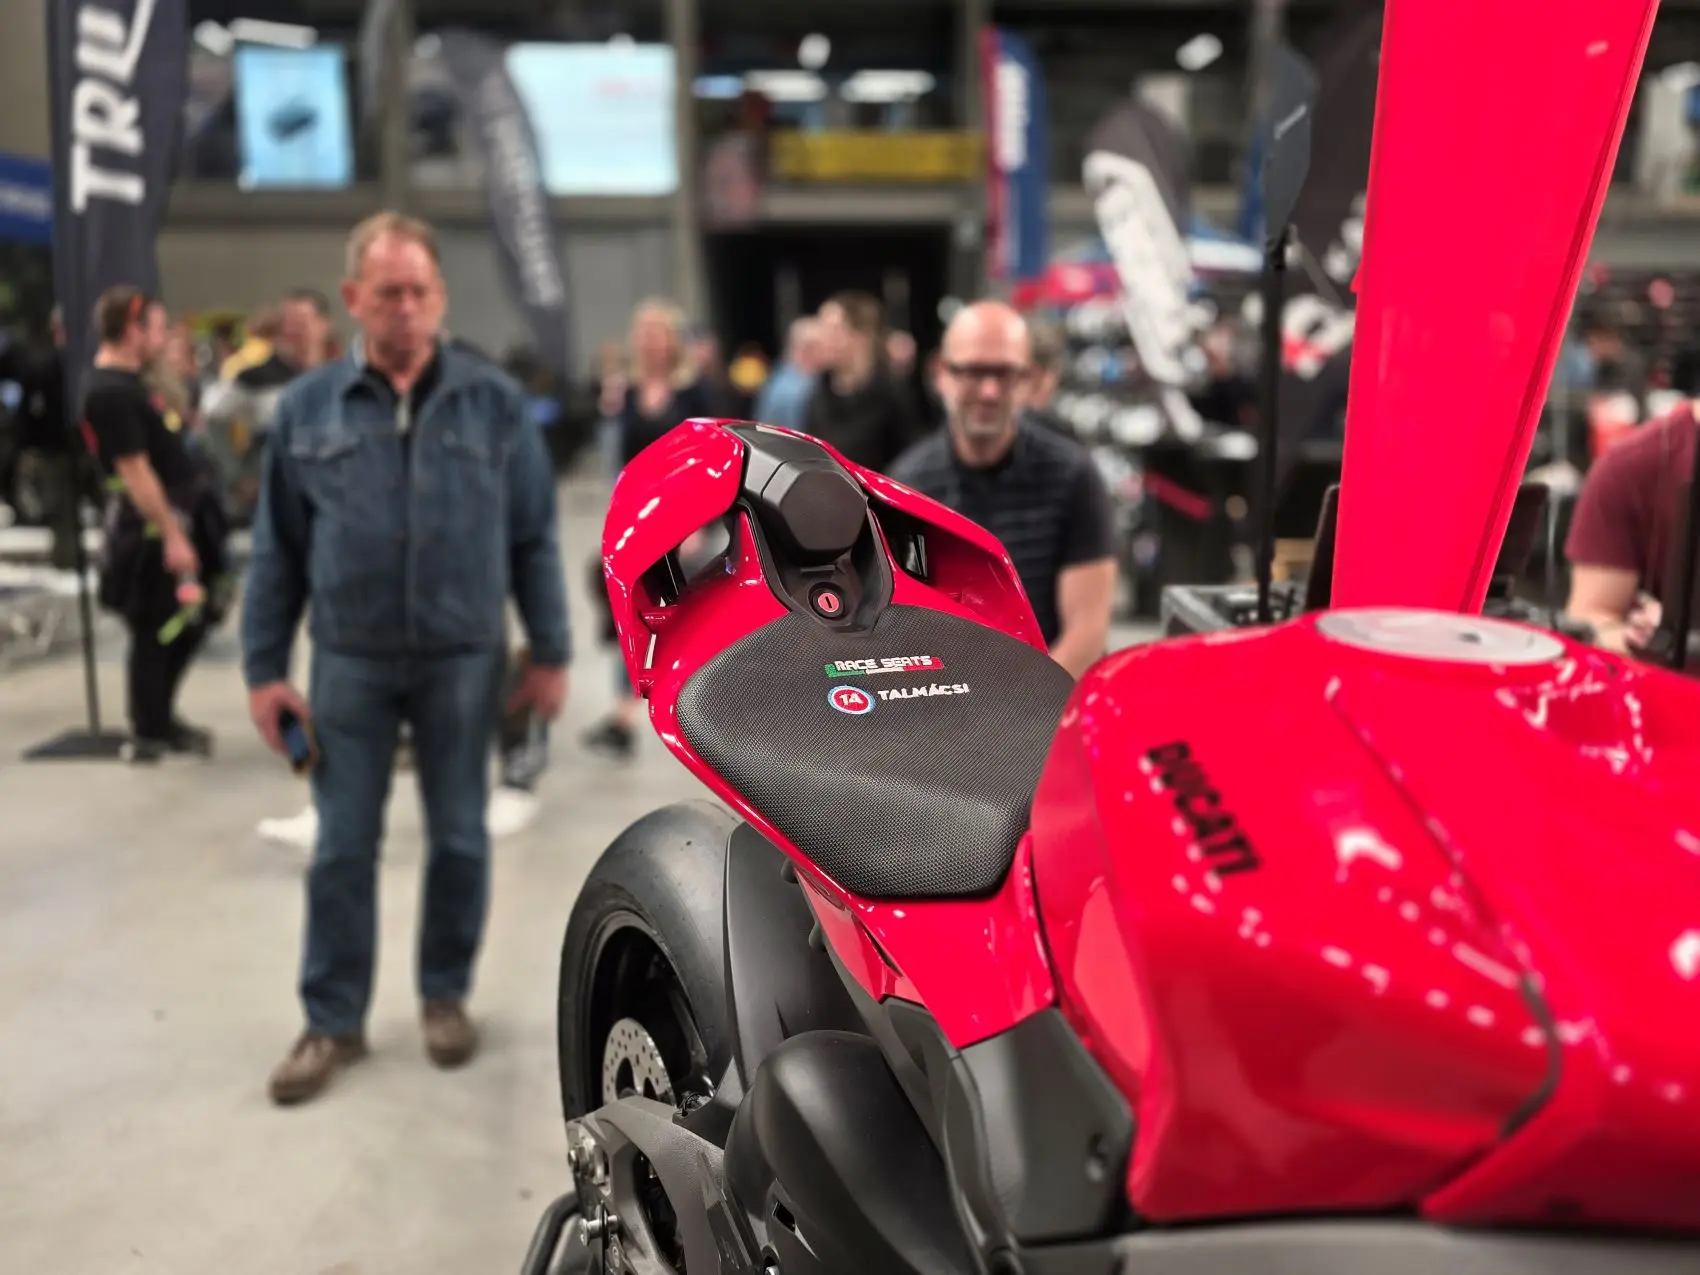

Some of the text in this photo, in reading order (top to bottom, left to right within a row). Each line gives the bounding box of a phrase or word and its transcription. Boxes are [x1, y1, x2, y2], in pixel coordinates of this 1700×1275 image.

[835, 655, 933, 672] RACE SEATS
[877, 683, 970, 701] TALMÁCSI
[1147, 740, 1264, 878] DUCATI
